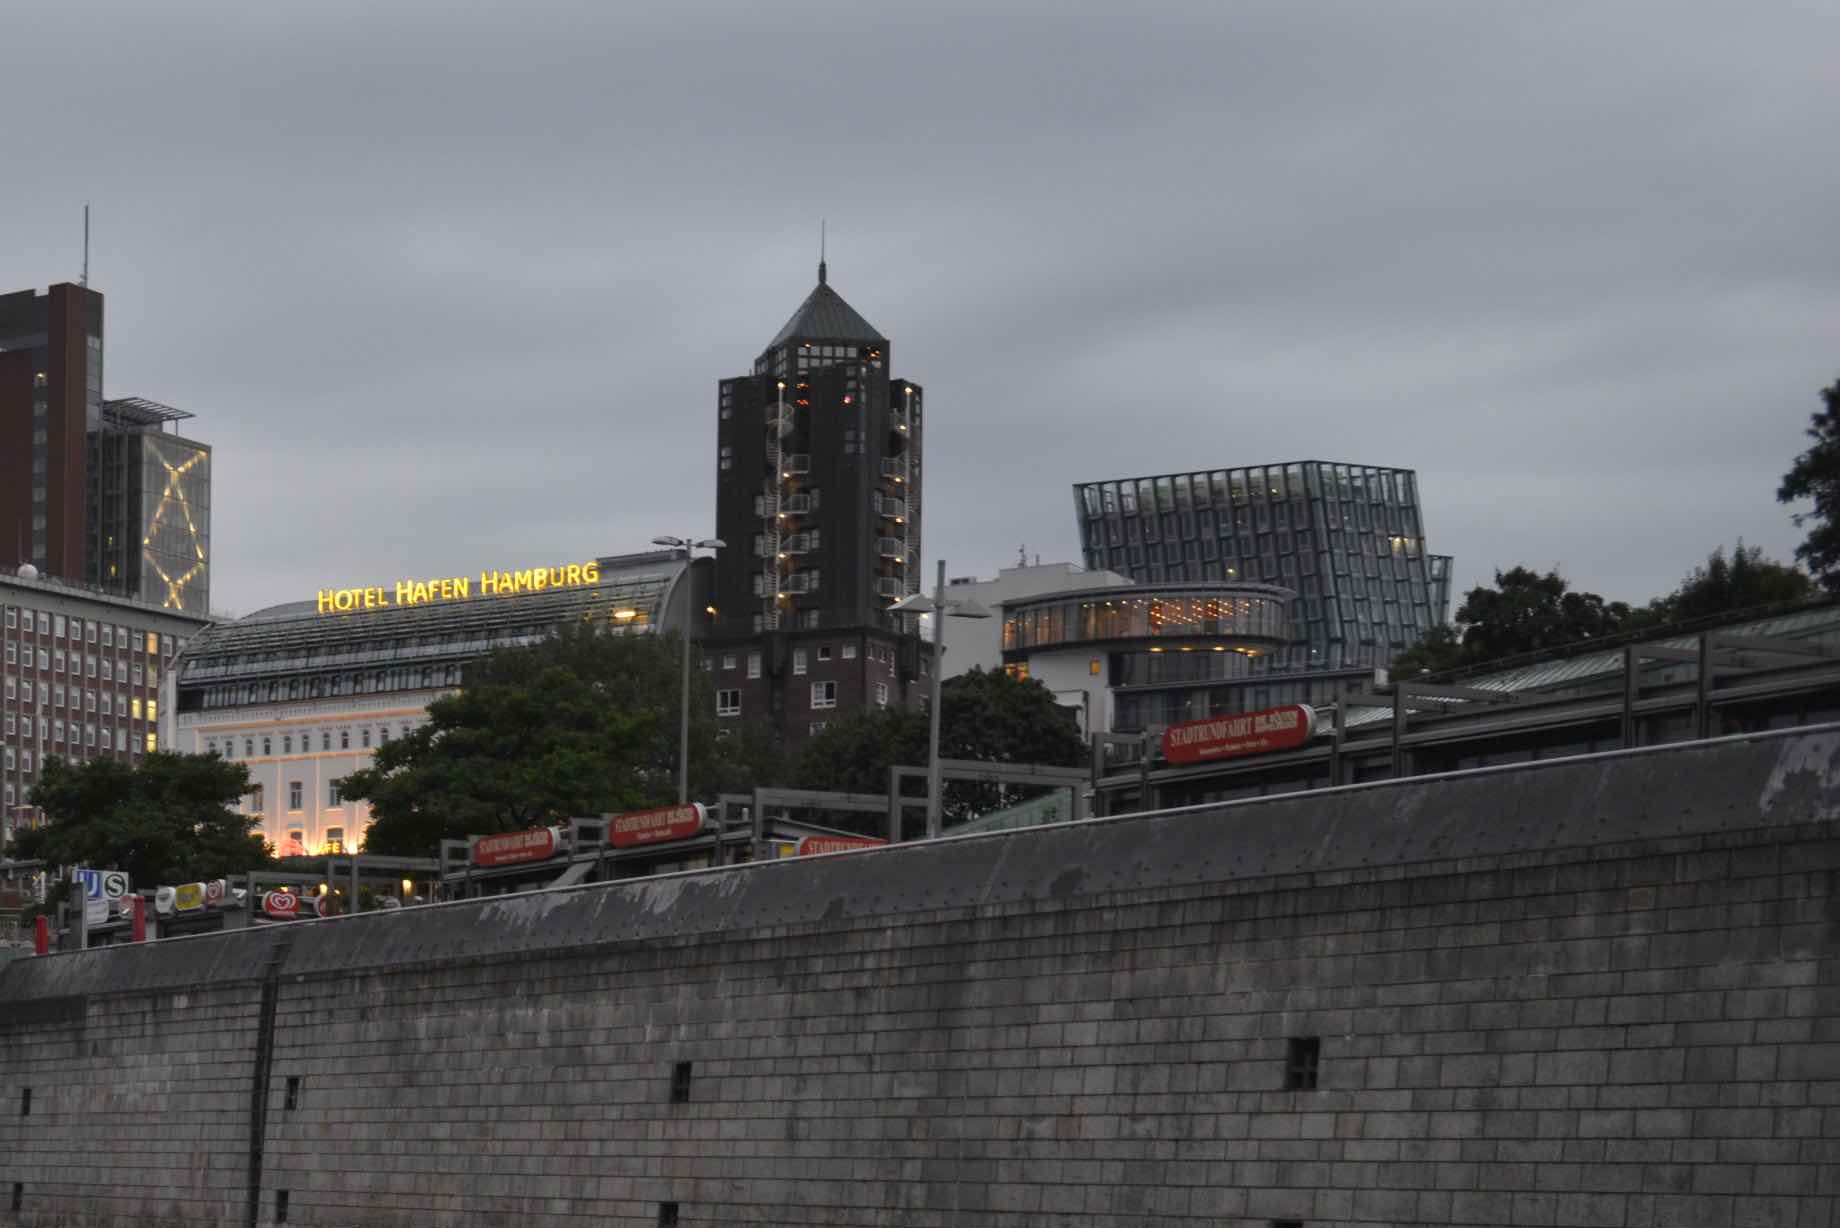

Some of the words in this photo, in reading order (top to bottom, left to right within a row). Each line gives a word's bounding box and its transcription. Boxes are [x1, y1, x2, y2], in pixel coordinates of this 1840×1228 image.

[318, 588, 388, 613] HOTEL
[396, 577, 468, 606] HAFEN
[481, 562, 599, 596] HAMBURG
[78, 872, 98, 896] U
[105, 874, 125, 897] S
